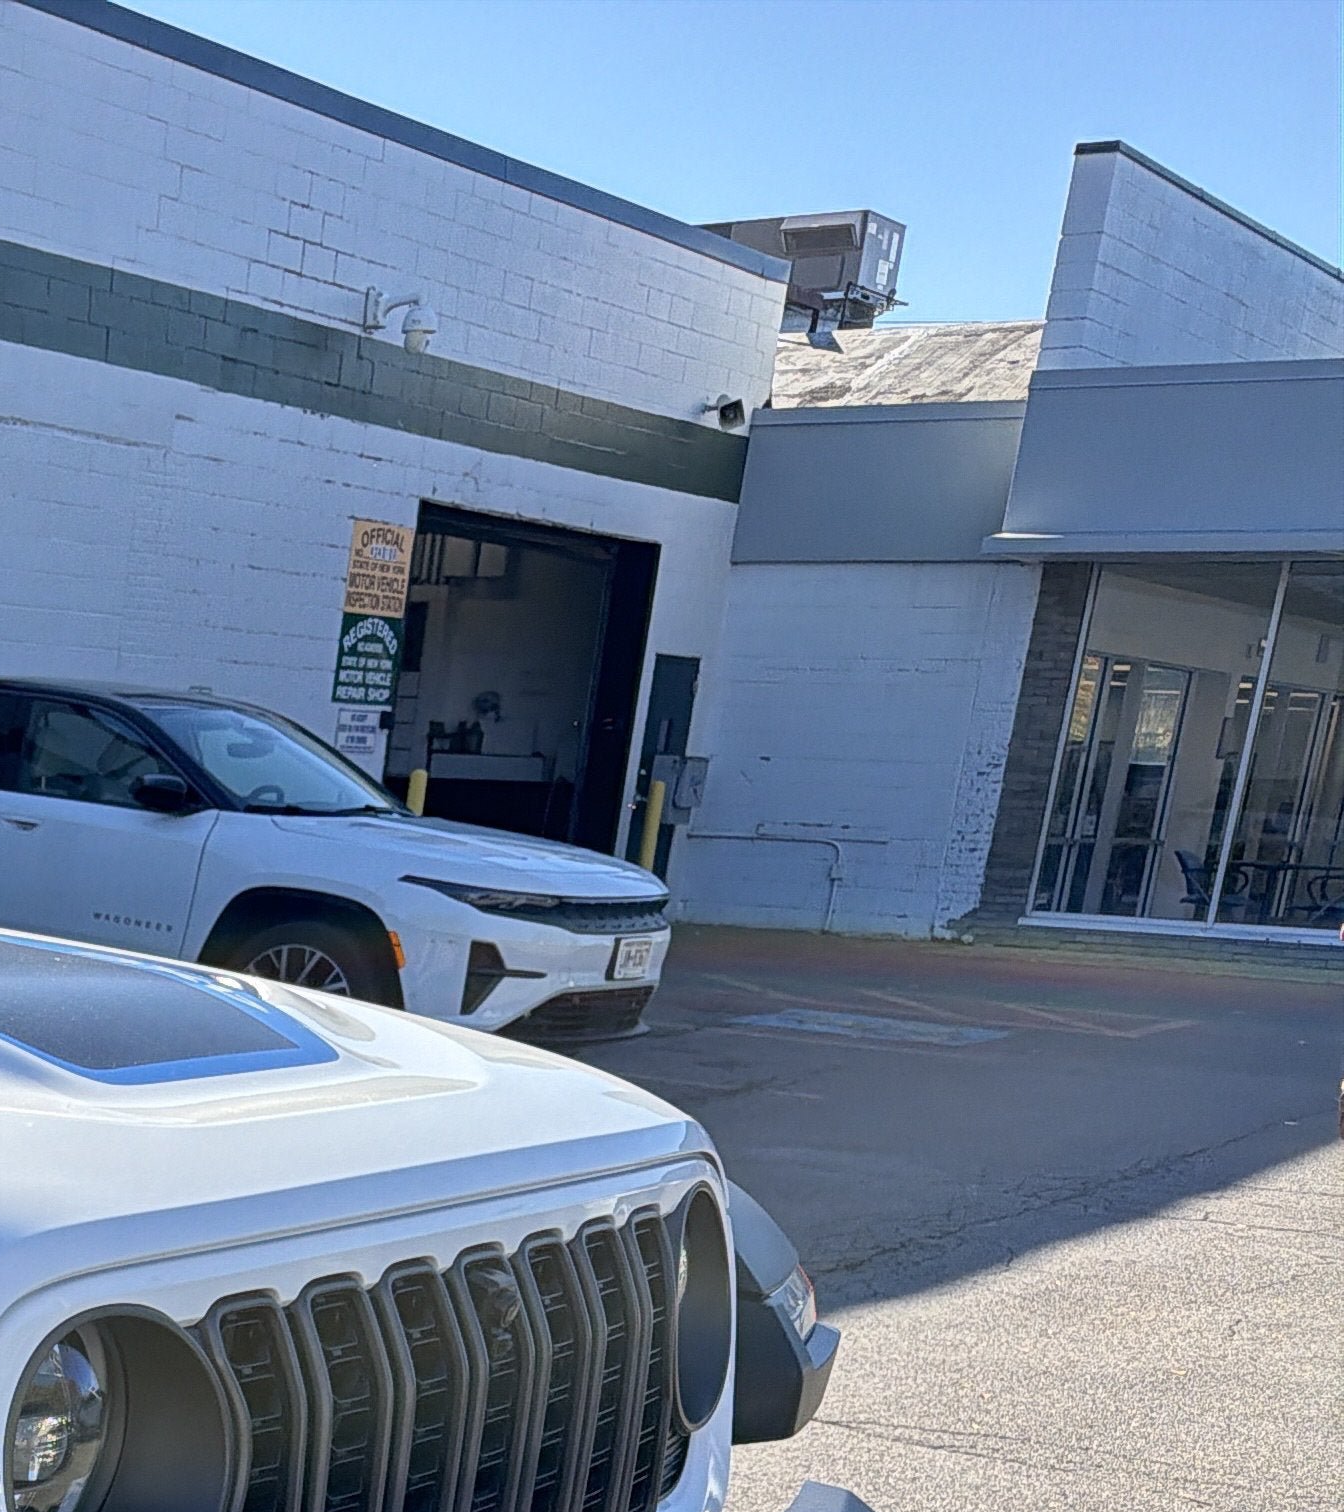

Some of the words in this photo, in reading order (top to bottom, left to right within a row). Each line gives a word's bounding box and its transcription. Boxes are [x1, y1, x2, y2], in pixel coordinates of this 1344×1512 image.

[361, 527, 404, 553] OFFICIAL
[348, 571, 376, 590] MOTOR
[377, 575, 405, 595] VEHICLE
[343, 617, 397, 655] REGISTERED
[335, 685, 366, 699] REPAIR
[367, 687, 390, 701] SHOP
